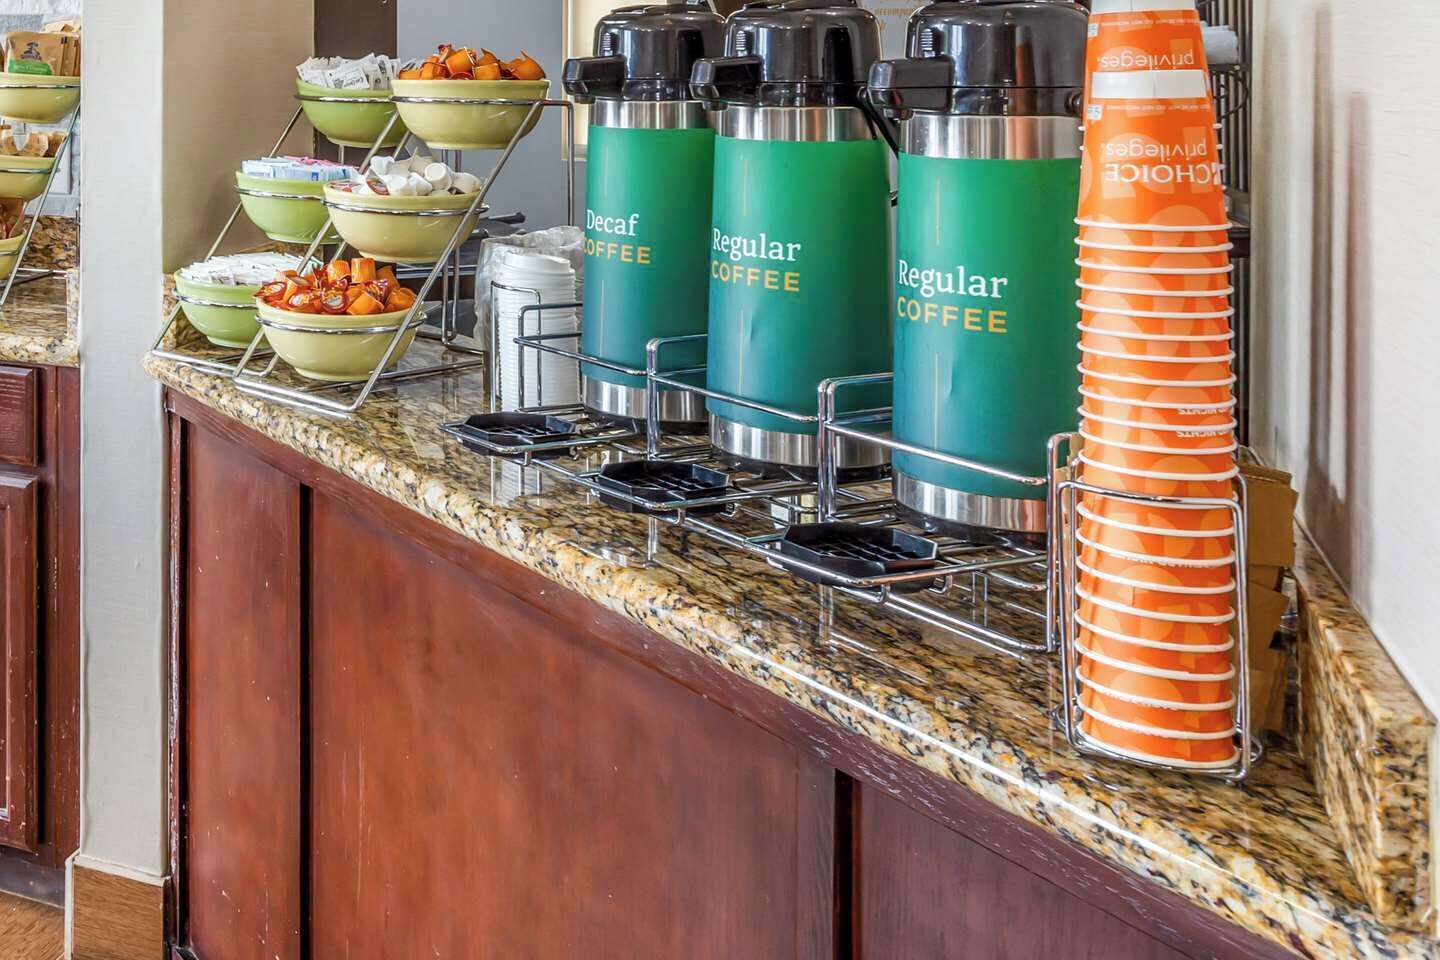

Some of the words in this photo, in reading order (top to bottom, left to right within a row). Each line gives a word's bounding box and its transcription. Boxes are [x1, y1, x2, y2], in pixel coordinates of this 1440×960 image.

[1104, 163, 1211, 185] CHOICE
[586, 209, 640, 237] Decaf
[582, 237, 652, 265] COFFEE
[712, 227, 802, 263] Regular
[711, 260, 801, 293] COFFEE
[897, 258, 1009, 299] Regular
[897, 295, 1008, 334] COFFEE
